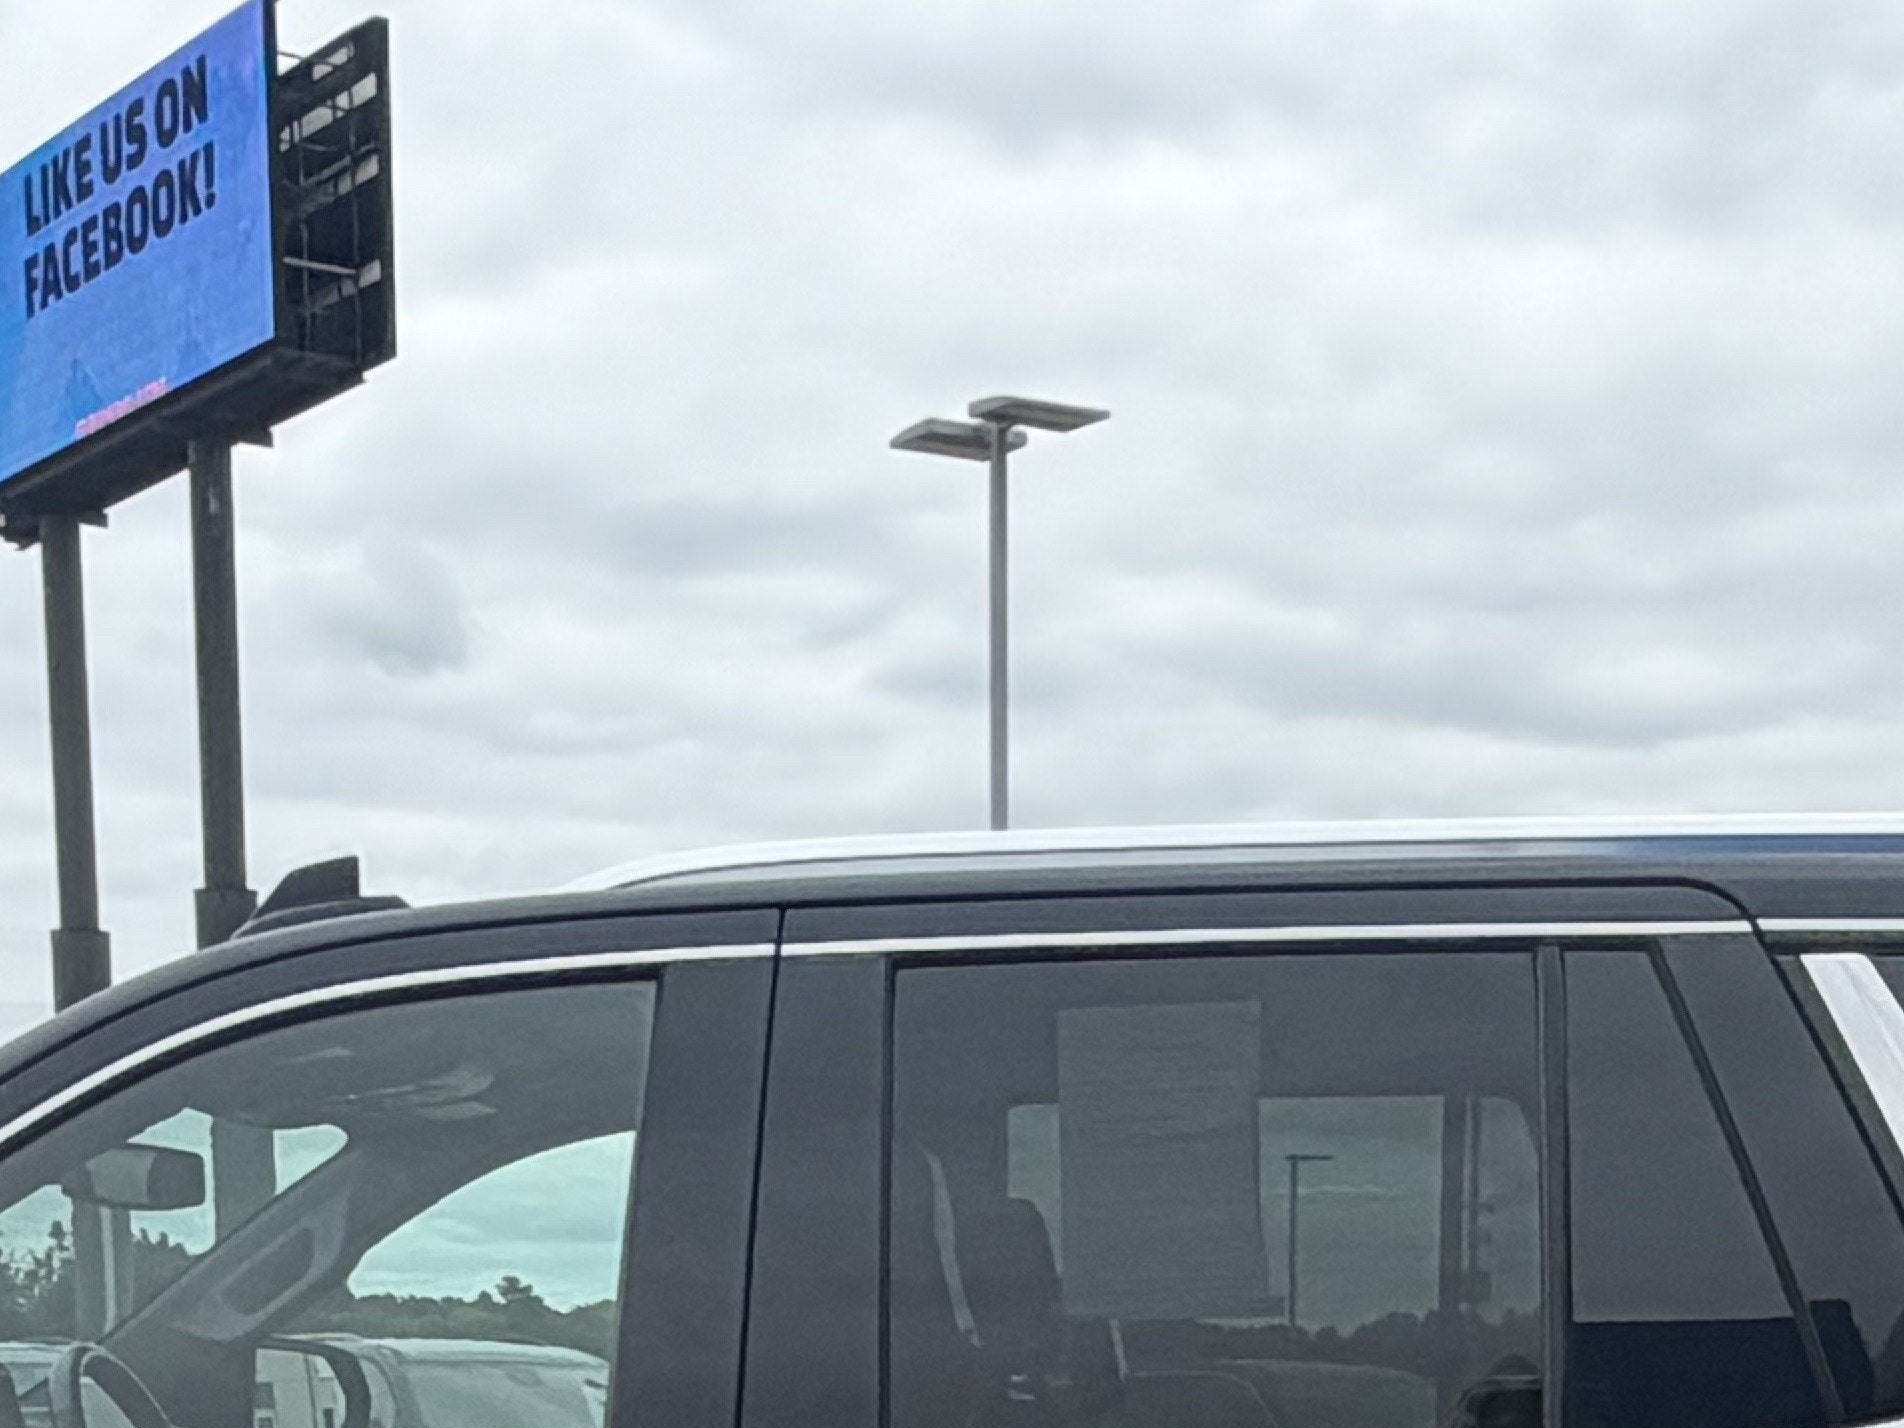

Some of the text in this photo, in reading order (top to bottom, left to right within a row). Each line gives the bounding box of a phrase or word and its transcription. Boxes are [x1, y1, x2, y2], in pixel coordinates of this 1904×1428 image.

[24, 54, 208, 237] LIKE US ON
[24, 139, 216, 320] FACEBOOK!
